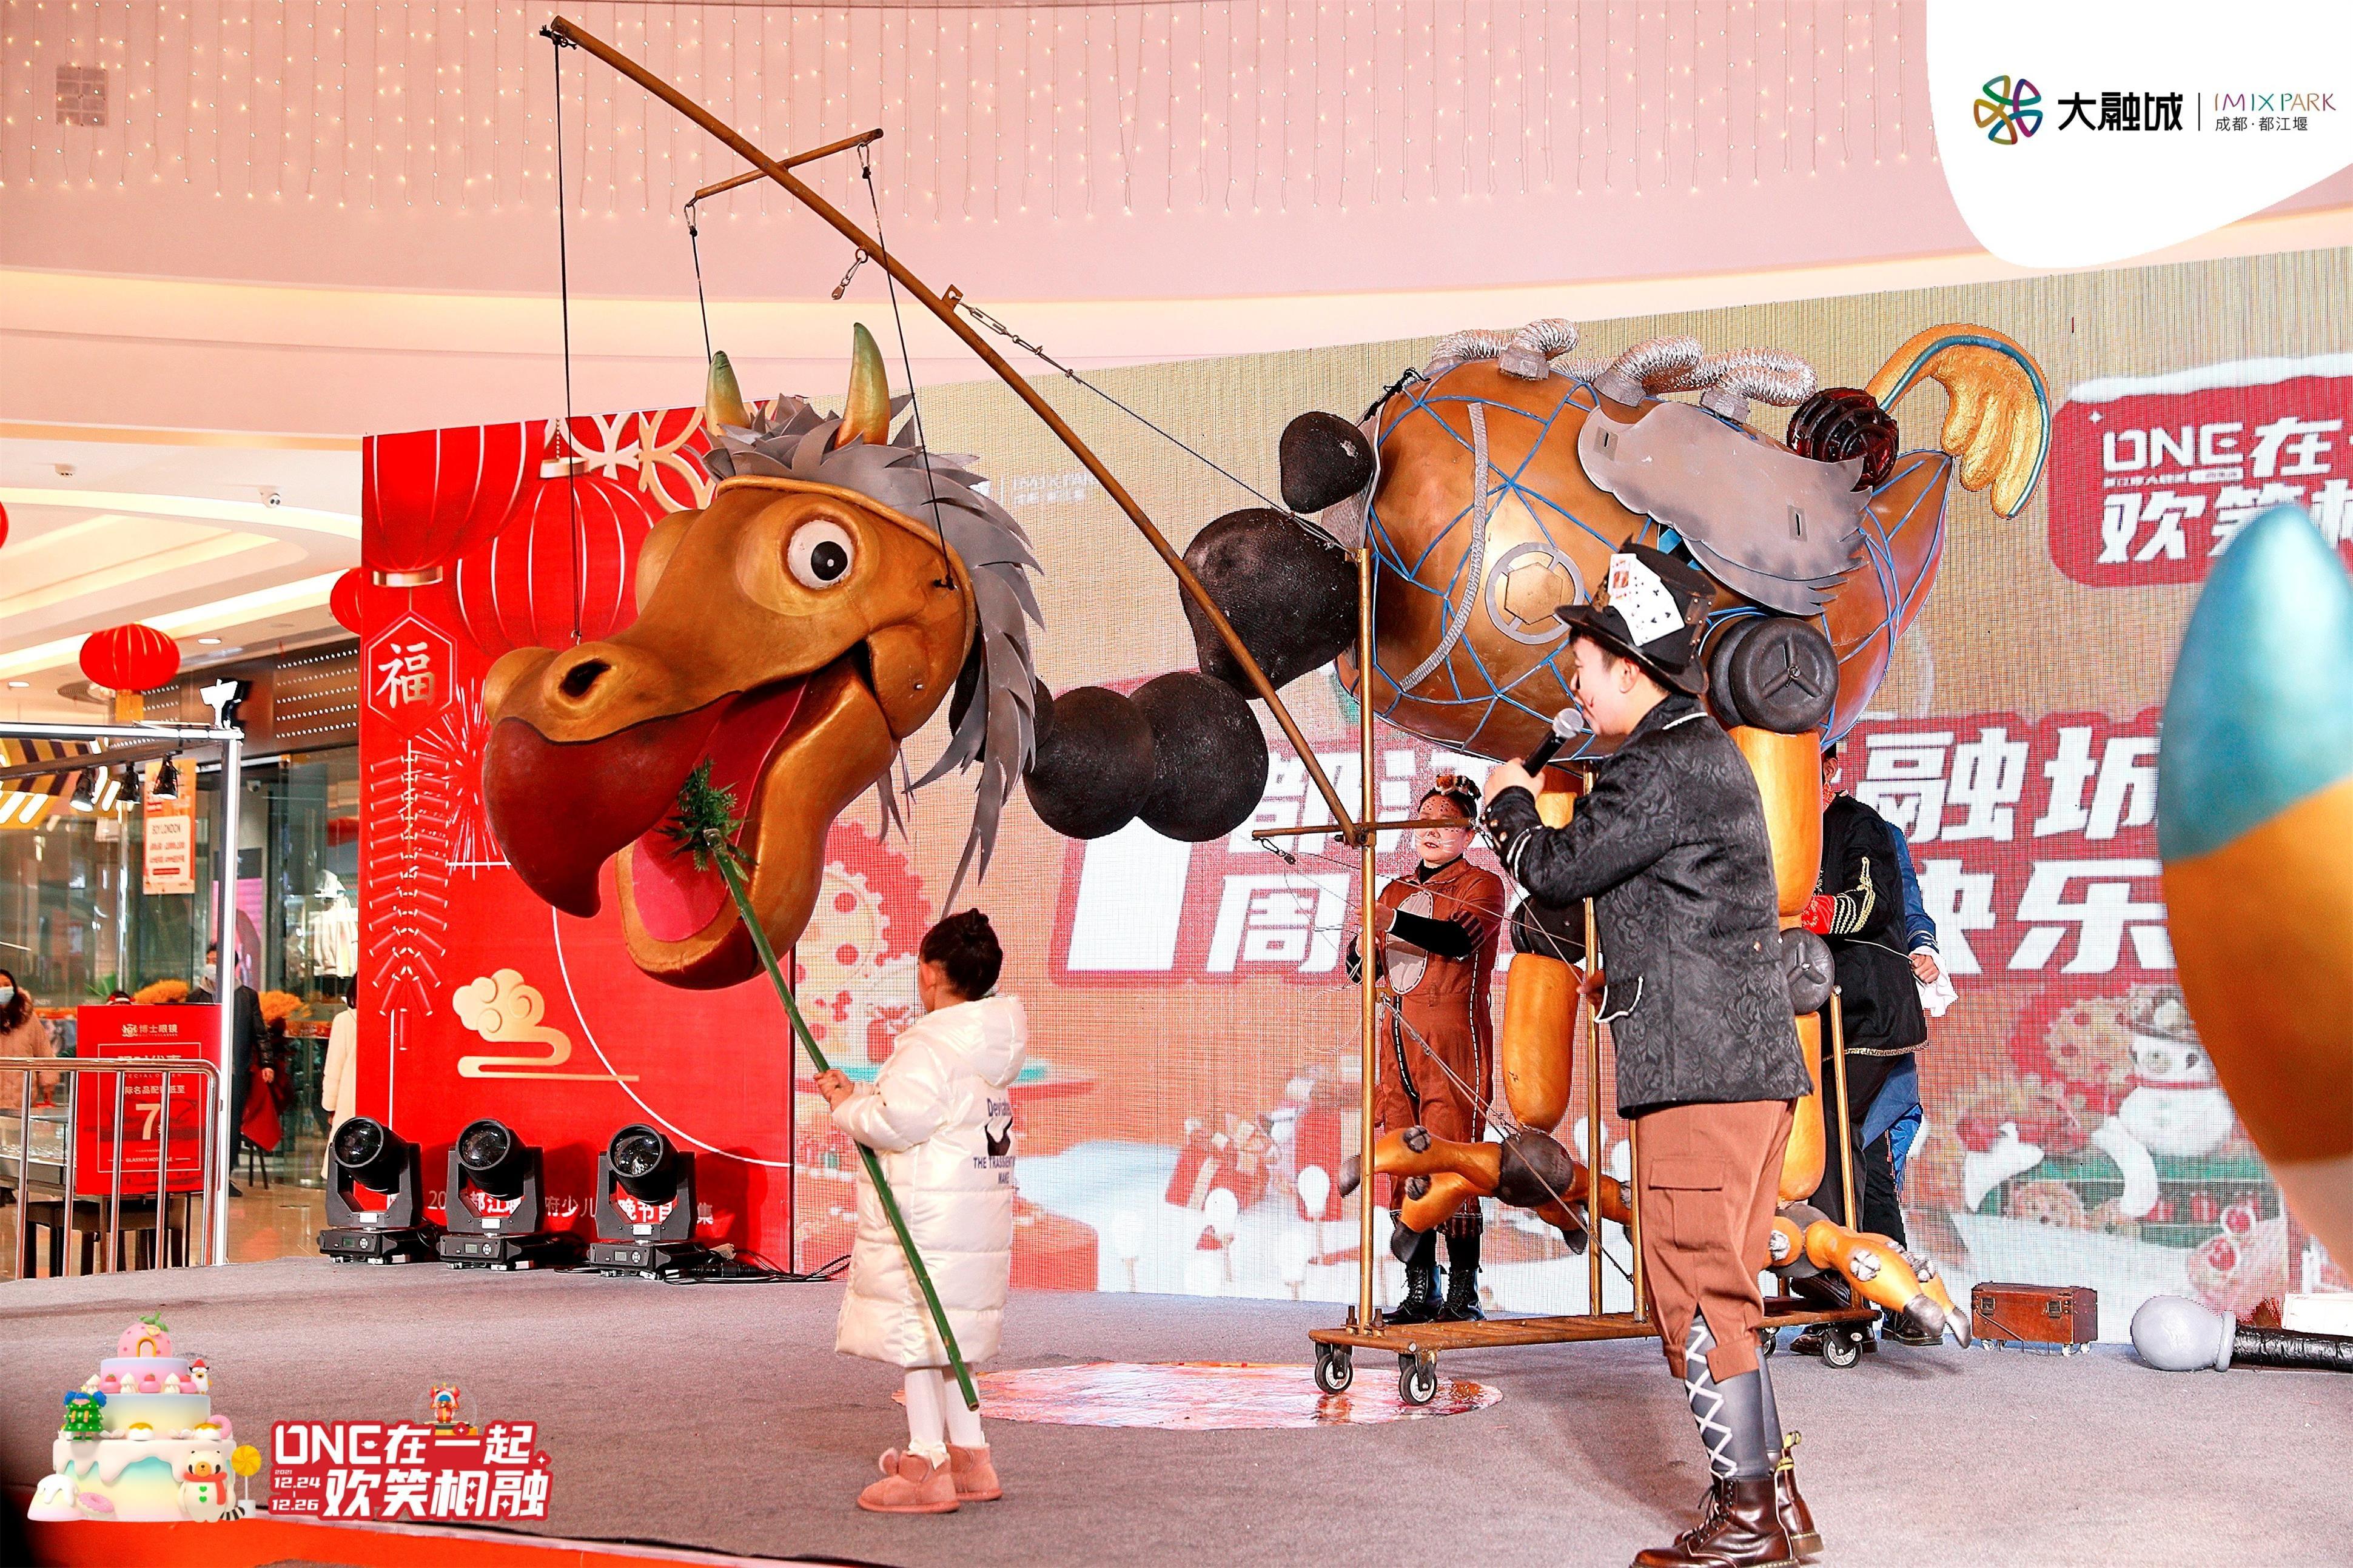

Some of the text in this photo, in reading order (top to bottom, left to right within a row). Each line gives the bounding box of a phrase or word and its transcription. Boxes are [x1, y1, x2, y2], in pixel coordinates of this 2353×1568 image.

[2103, 416, 2353, 478] ONE在
[375, 642, 435, 709] 福
[139, 1024, 178, 1033] 博士眼镜
[135, 1103, 161, 1140] 7
[973, 1157, 987, 1169] THE
